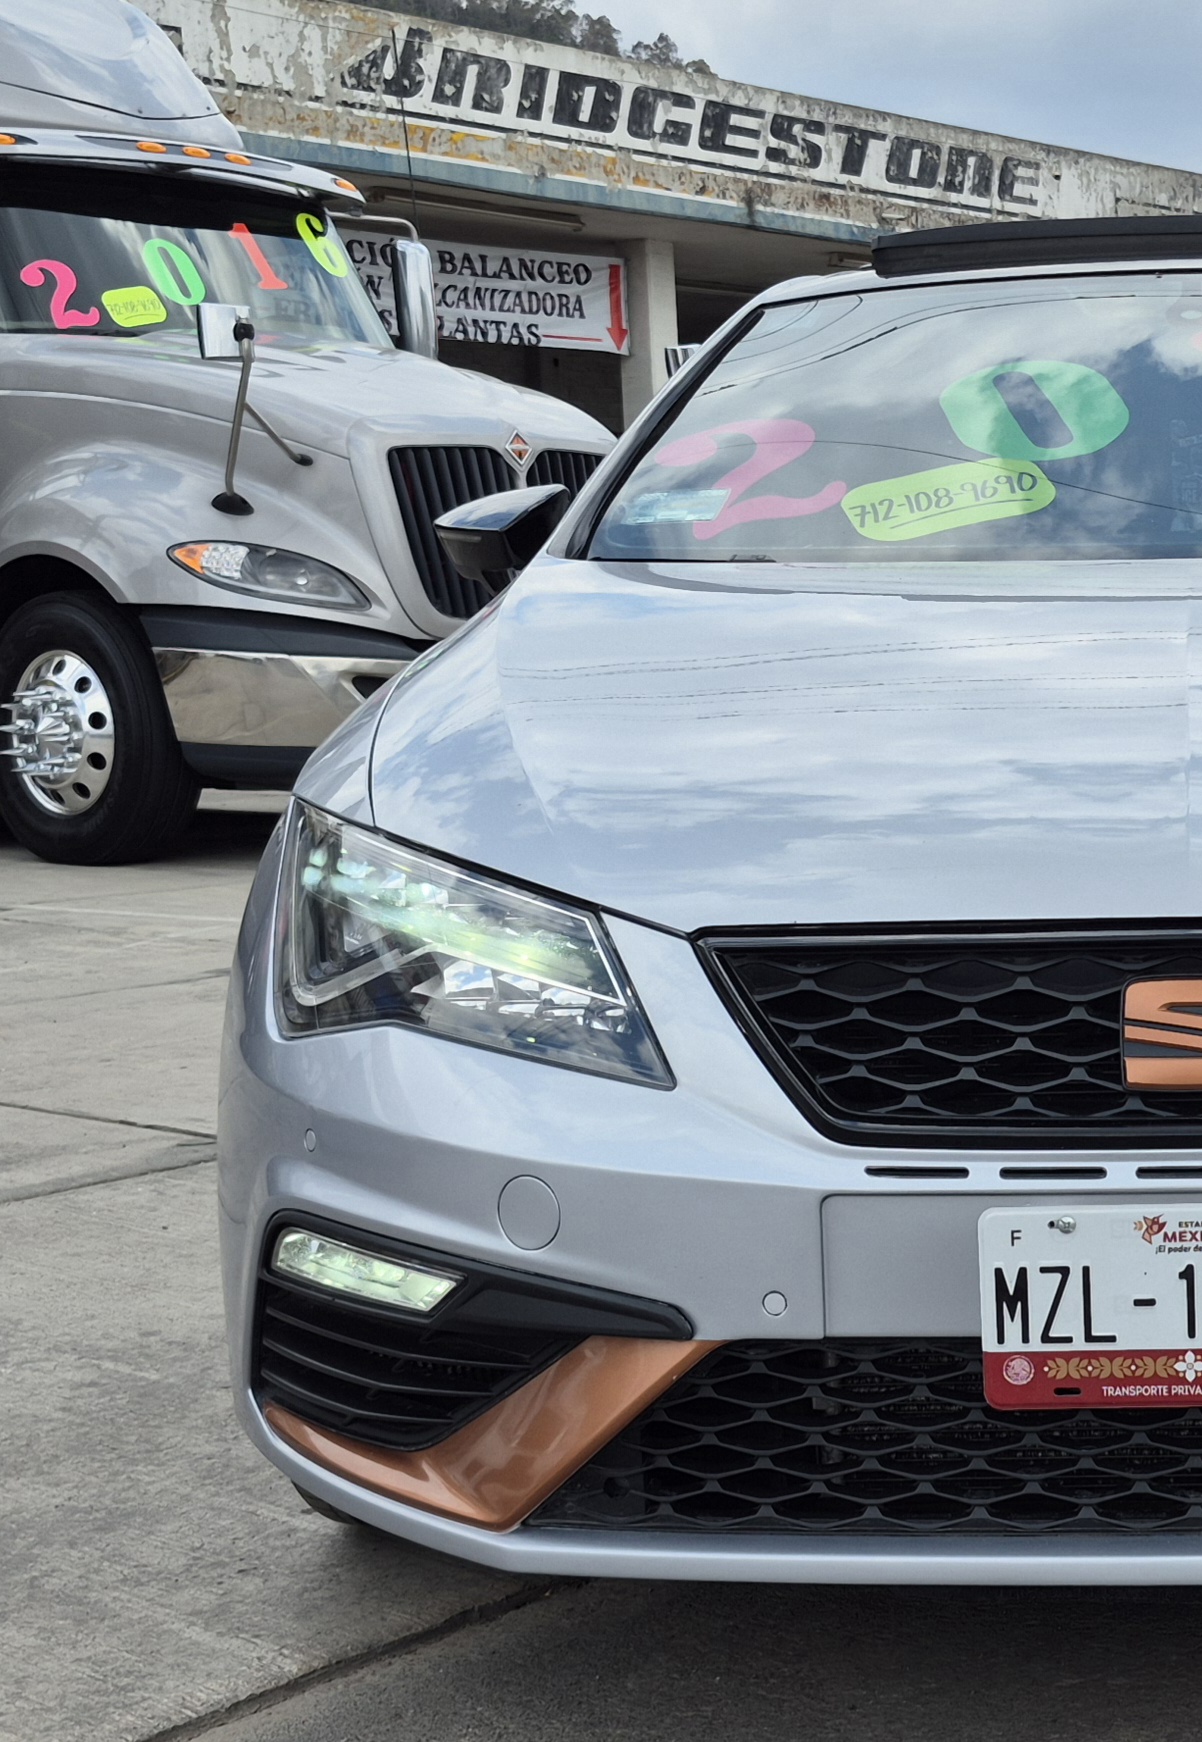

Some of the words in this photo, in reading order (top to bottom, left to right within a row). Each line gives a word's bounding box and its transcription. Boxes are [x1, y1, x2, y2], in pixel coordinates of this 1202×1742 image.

[437, 251, 593, 286] BALANCEO
[437, 315, 542, 347] LANTAS
[848, 472, 1038, 528] 712-108-9690
[1010, 1229, 1022, 1247] F
[1168, 1244, 1191, 1254] poder
[1193, 1244, 1202, 1252] de
[1102, 1385, 1169, 1397] TRANSPORTE
